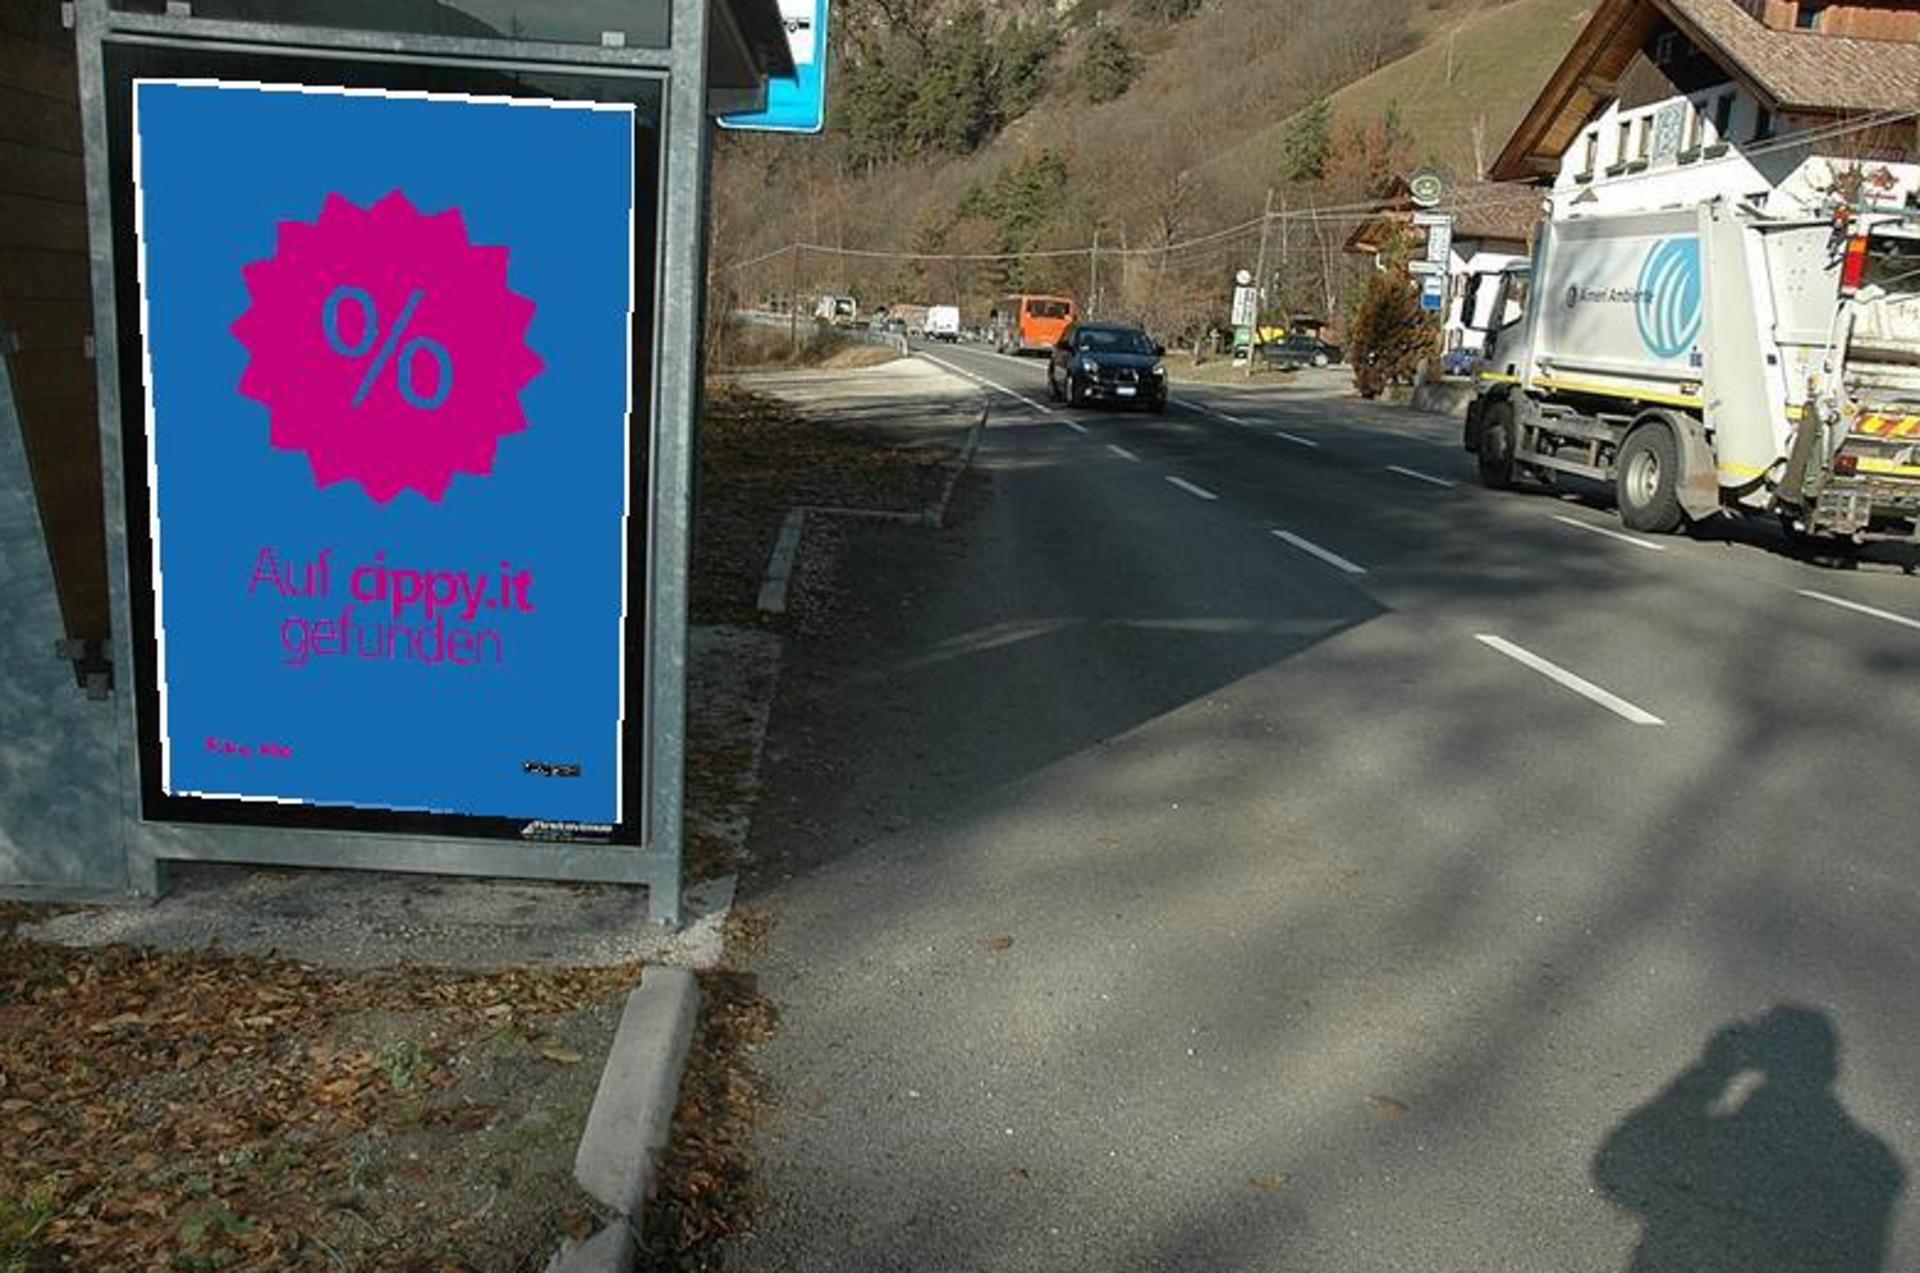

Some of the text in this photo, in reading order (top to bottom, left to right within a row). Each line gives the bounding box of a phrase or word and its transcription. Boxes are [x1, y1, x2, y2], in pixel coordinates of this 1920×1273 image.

[321, 284, 452, 409] %
[248, 547, 535, 621] Auf cippy.it
[280, 604, 502, 668] gefunden
